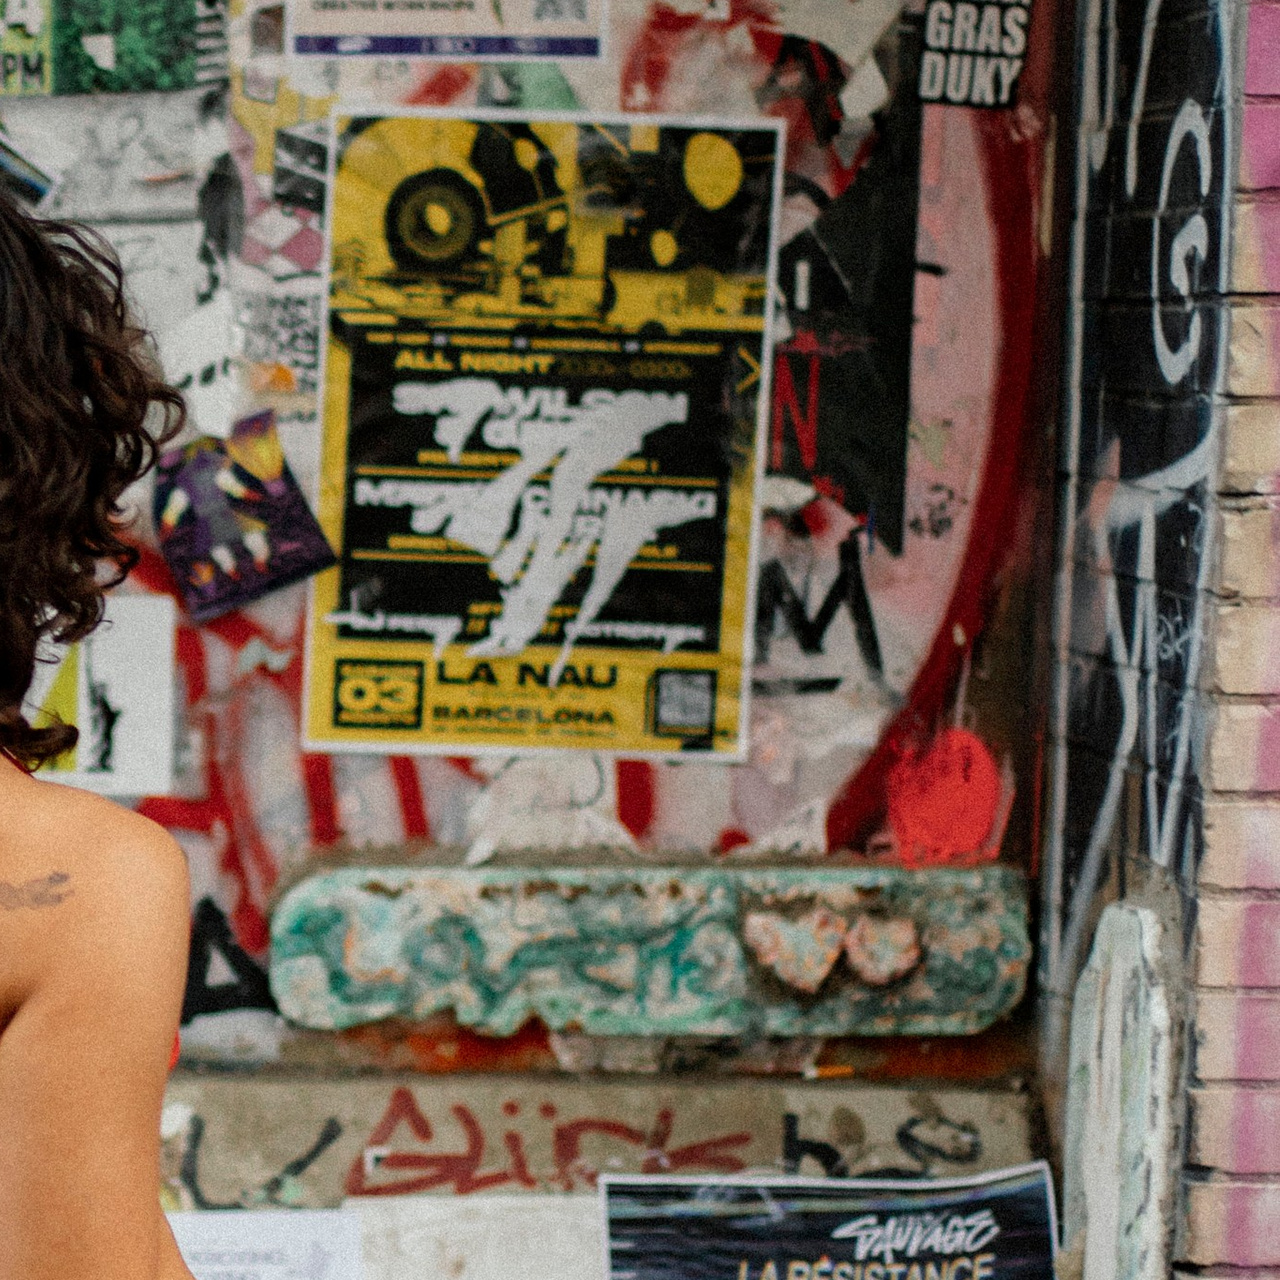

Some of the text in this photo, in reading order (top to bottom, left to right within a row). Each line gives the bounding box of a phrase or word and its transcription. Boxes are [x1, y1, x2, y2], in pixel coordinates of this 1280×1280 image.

[926, 0, 1031, 58] GRAS
[920, 49, 1024, 107] DUKY
[394, 348, 454, 372] ALL
[459, 350, 557, 376] NIGHT
[435, 659, 619, 691] LA NAU
[431, 704, 617, 727] BARCELONA
